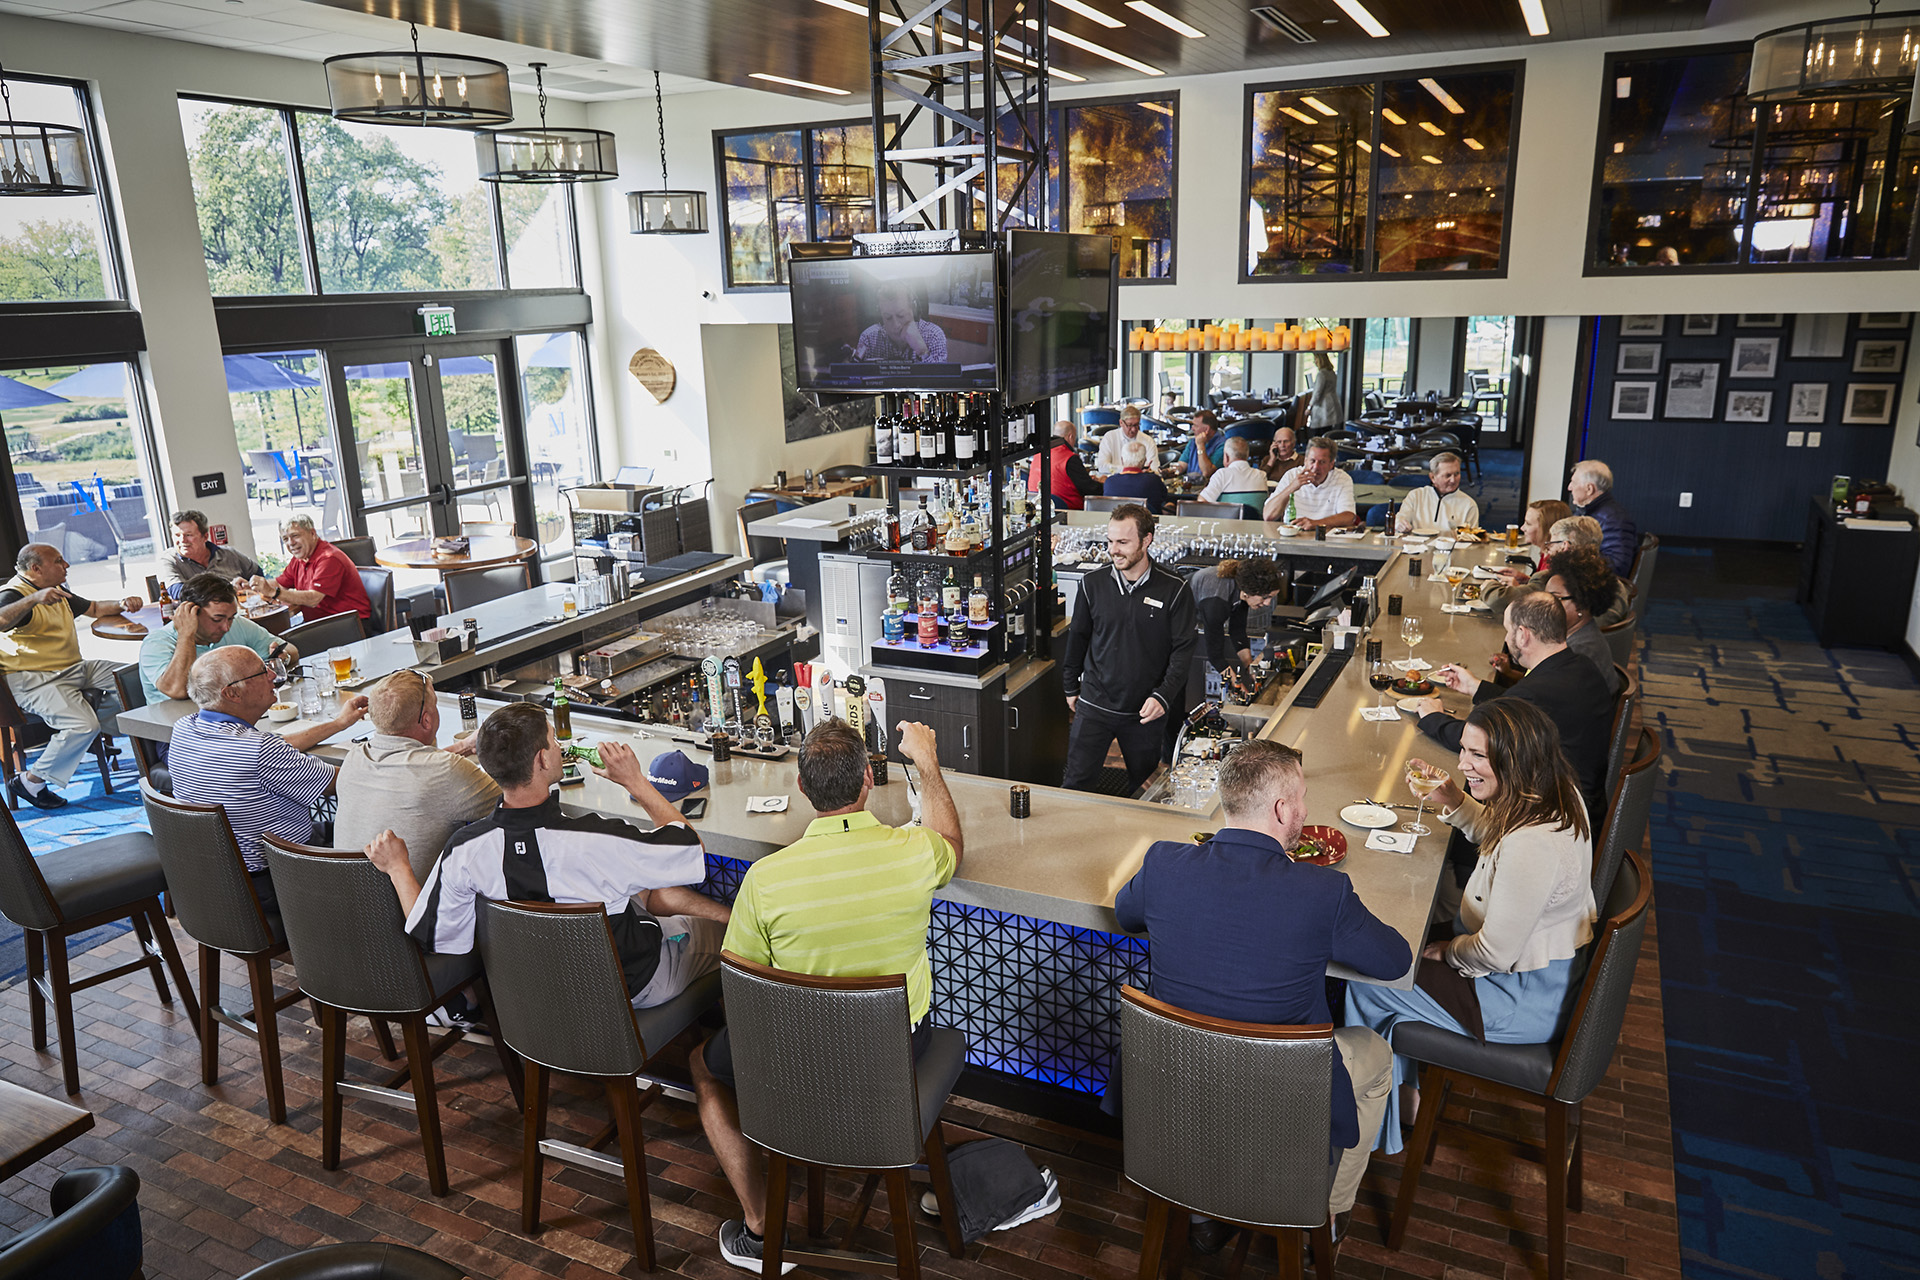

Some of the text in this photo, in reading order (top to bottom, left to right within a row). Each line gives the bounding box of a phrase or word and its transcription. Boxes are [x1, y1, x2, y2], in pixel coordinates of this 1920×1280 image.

[430, 314, 451, 336] EXIT
[201, 480, 219, 490] EXIT
[849, 704, 858, 727] RDS
